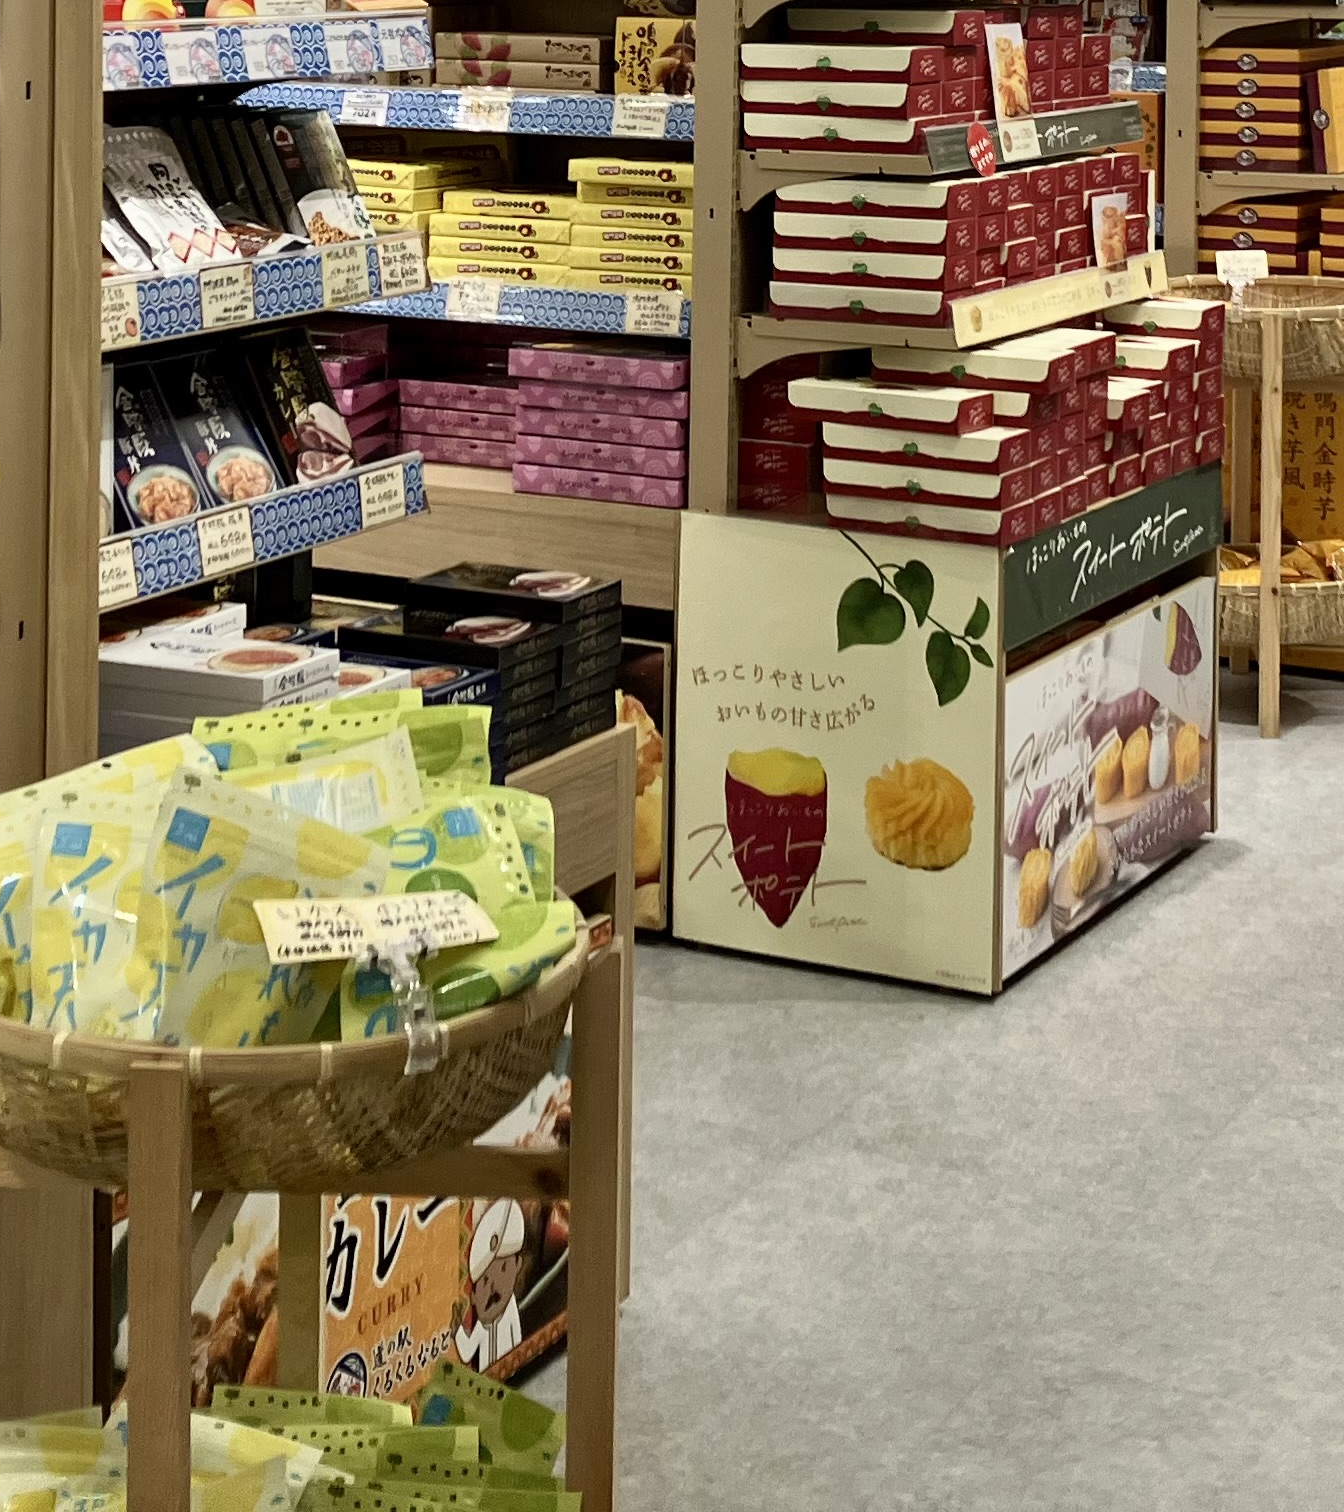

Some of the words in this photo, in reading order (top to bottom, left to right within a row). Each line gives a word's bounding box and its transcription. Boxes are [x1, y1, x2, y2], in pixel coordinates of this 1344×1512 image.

[1312, 390, 1338, 522] 鳴門金時芋
[1070, 538, 1126, 604] スイート
[1129, 502, 1187, 562] ポテト
[692, 664, 846, 689] ほっこりやさしい
[716, 693, 876, 733] おいもの甘さ広がる
[687, 823, 826, 882] スイート
[731, 869, 867, 912] ポテト
[358, 1271, 425, 1334] CURRY
